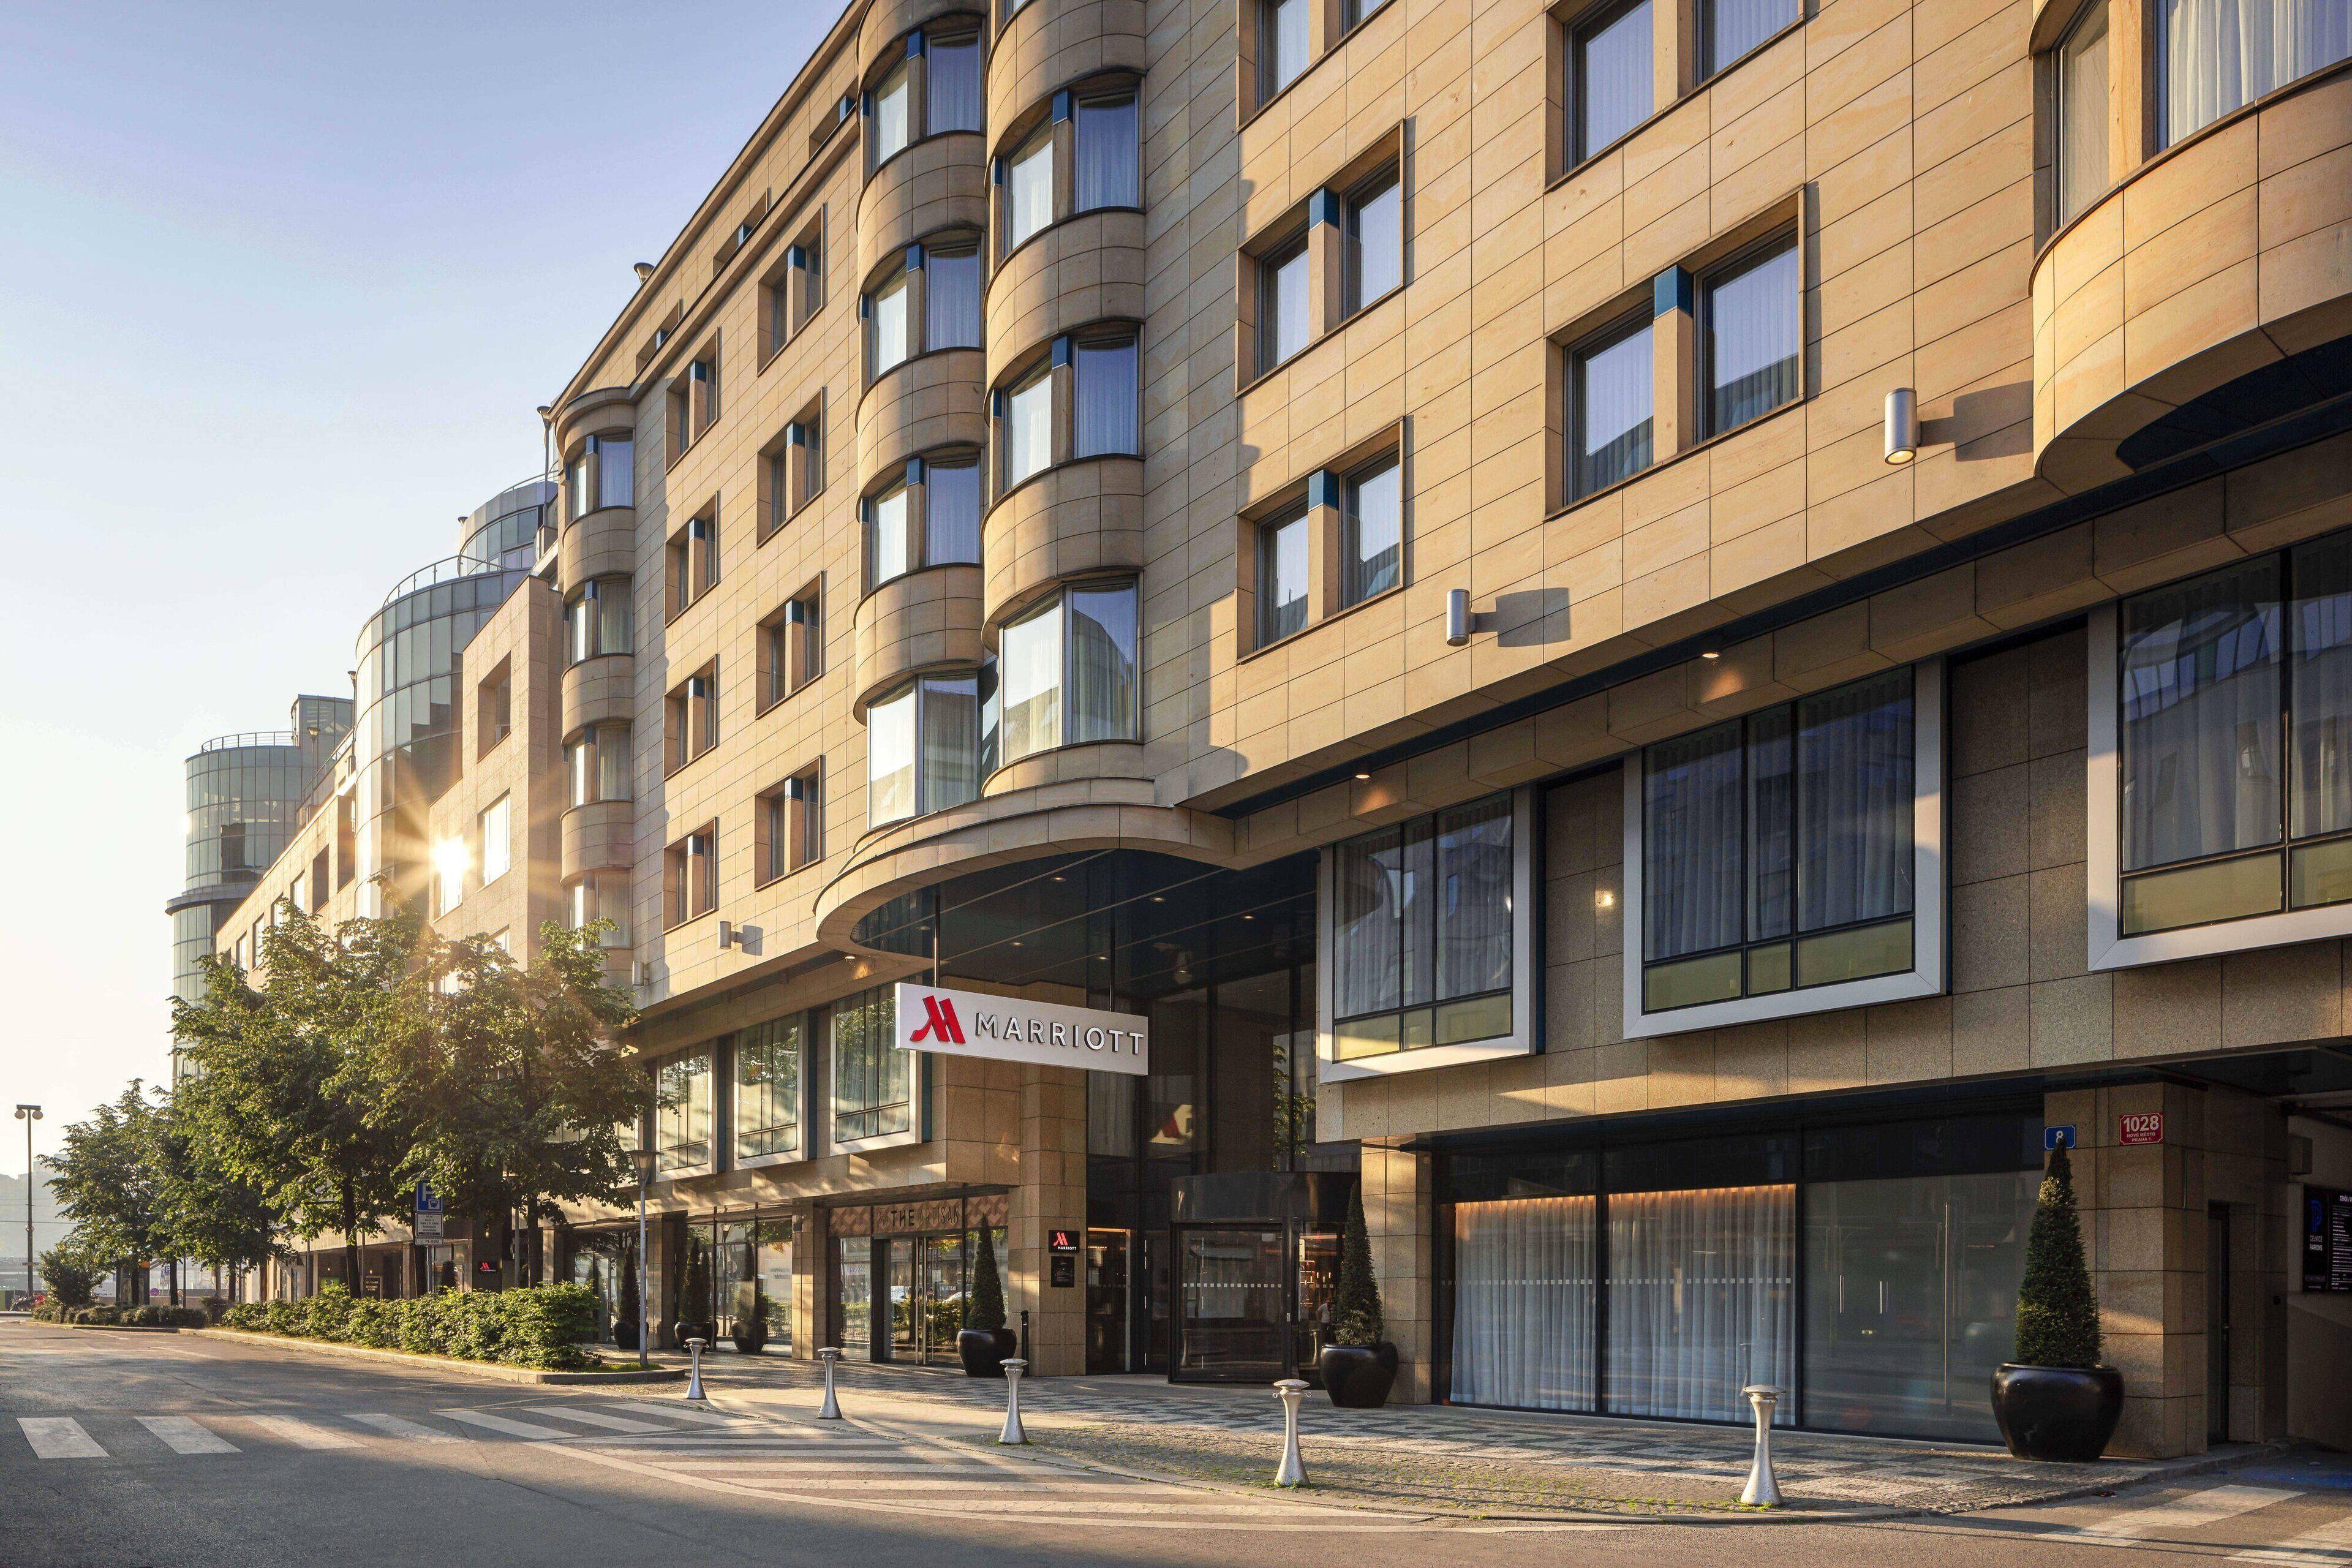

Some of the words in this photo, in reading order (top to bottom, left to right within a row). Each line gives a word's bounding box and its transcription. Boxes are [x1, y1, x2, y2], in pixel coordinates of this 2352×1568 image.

[976, 1012, 1144, 1055] MARRIOTT
[2124, 1115, 2159, 1133] 1028
[891, 1208, 914, 1227] THE
[919, 1205, 959, 1226] ARTISAN
